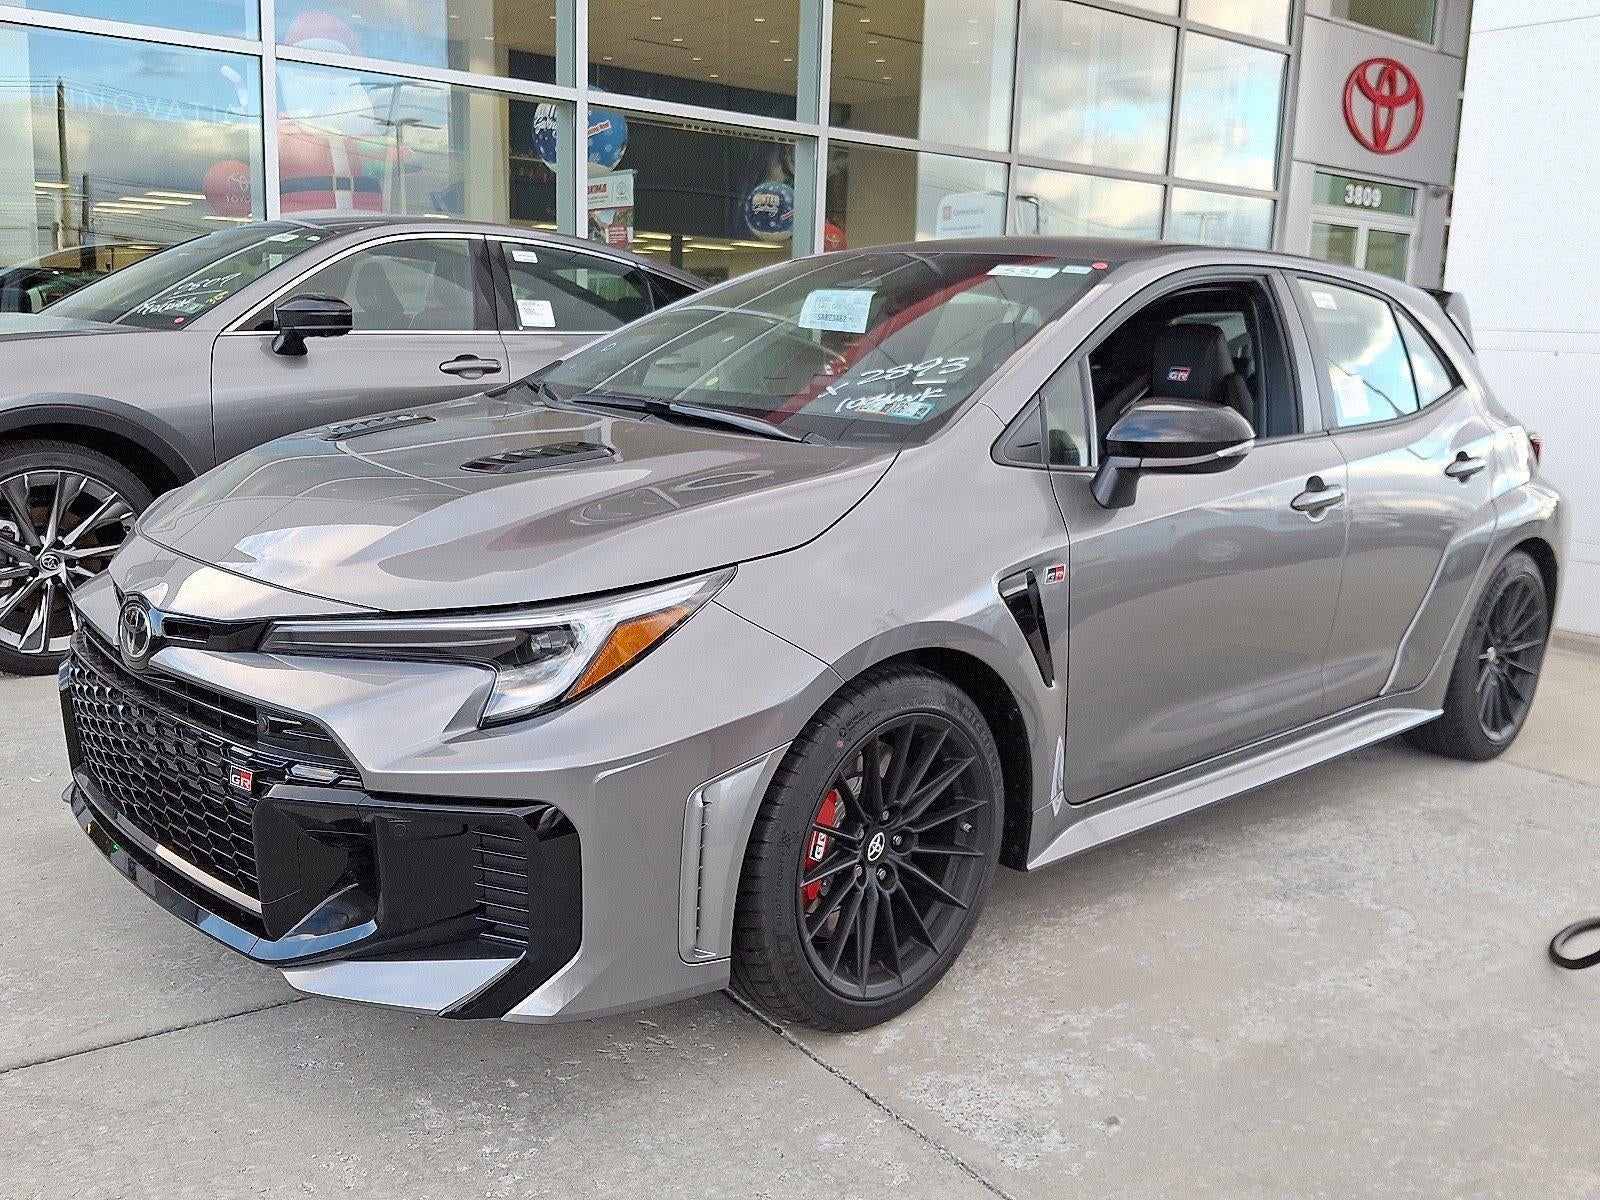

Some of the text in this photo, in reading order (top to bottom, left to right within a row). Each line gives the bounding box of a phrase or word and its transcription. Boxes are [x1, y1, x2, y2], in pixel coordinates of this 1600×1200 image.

[1345, 184, 1382, 208] 3809
[857, 357, 970, 385] 2893
[231, 771, 251, 790] GR
[813, 831, 827, 861] GR
